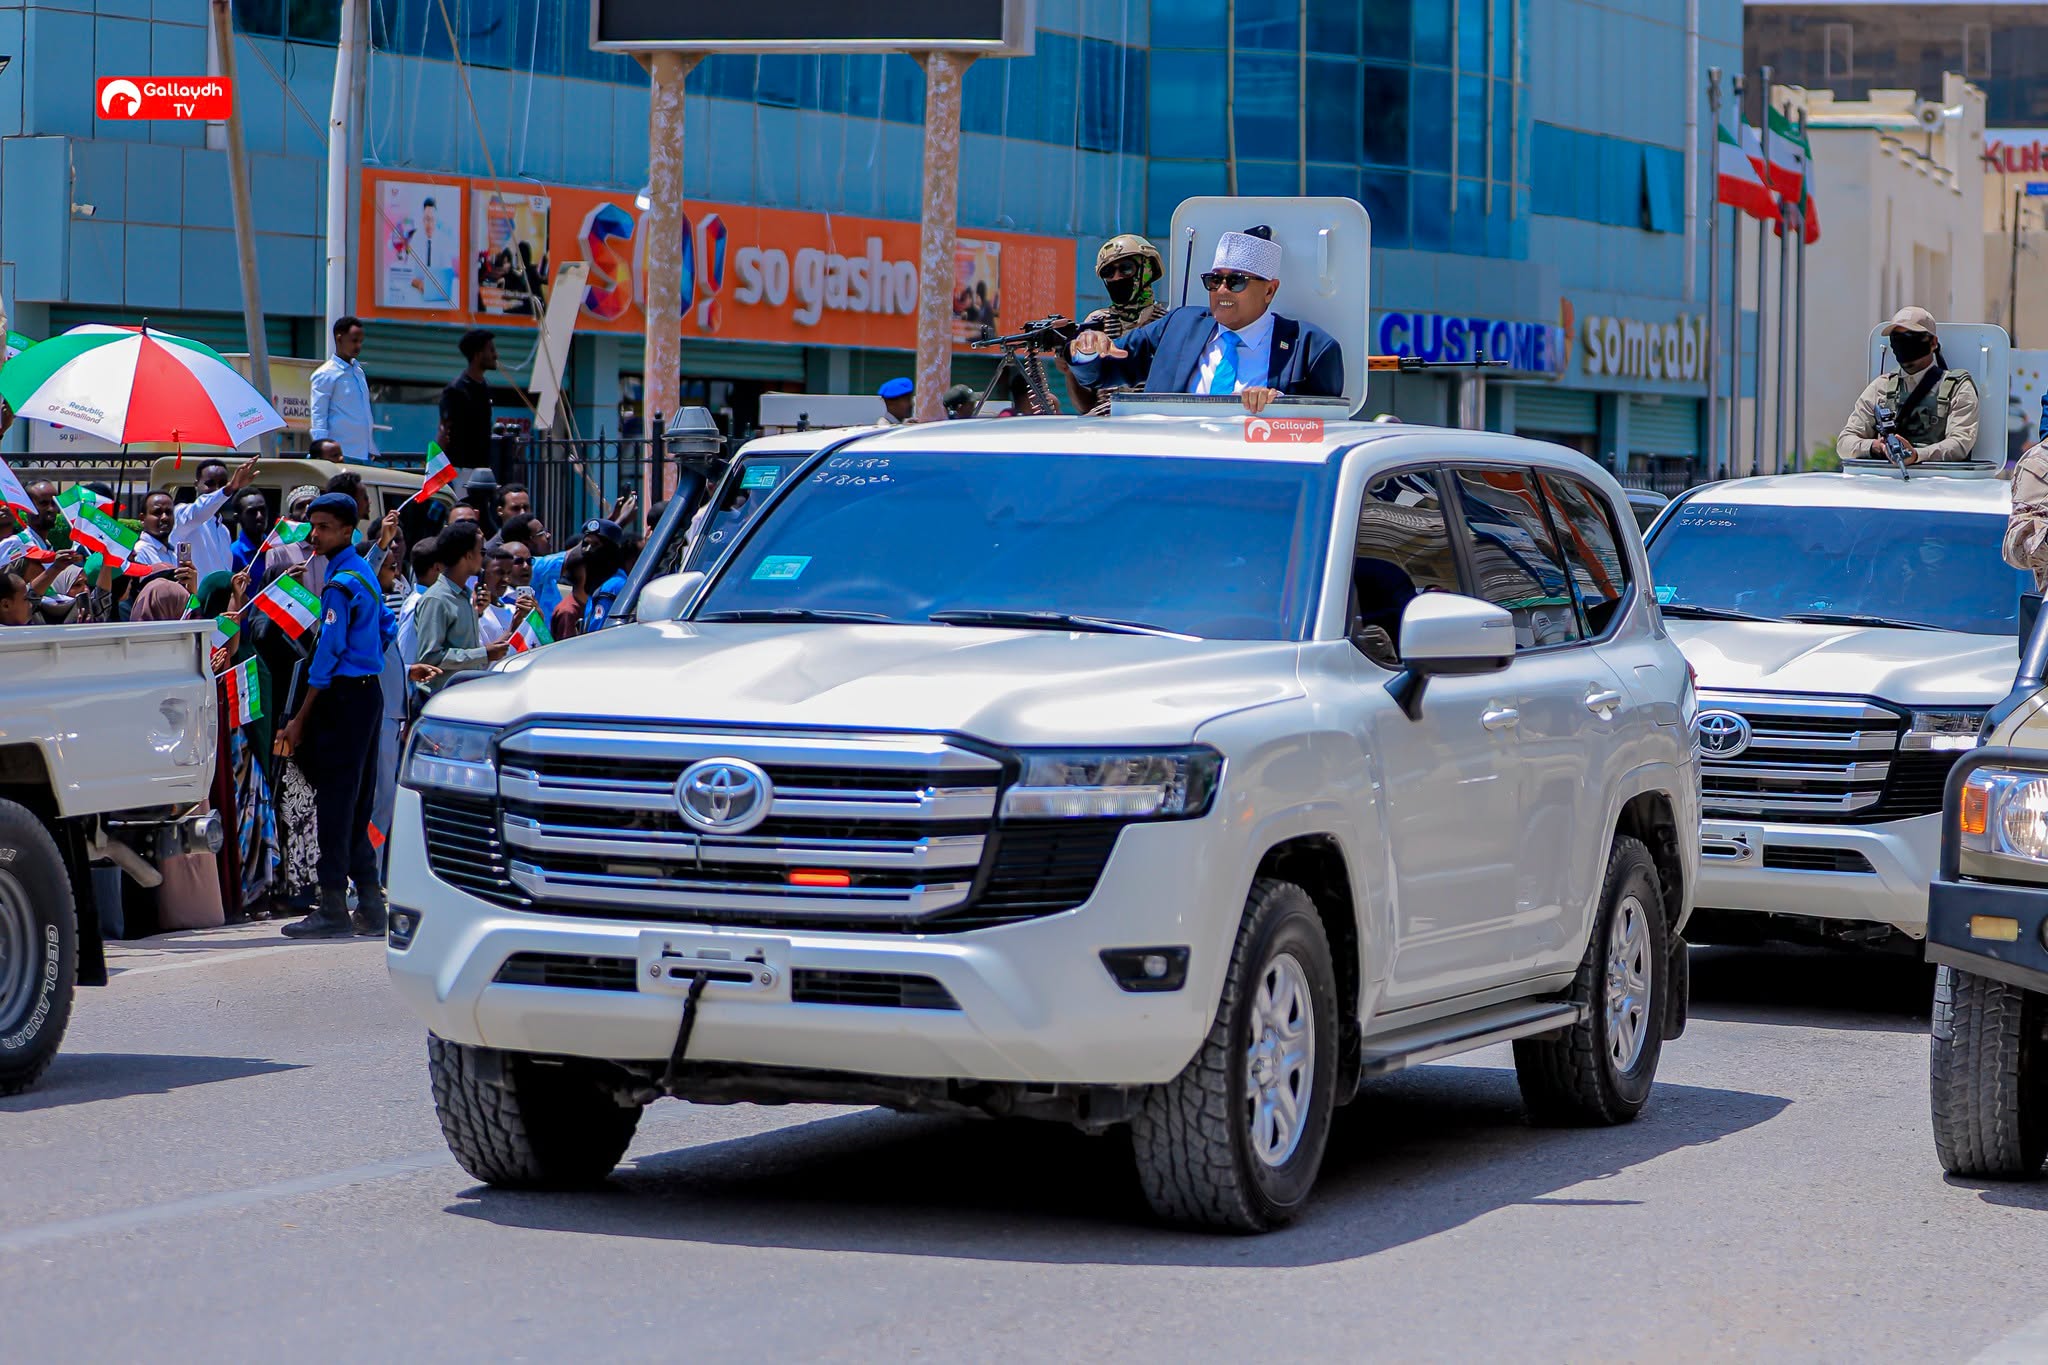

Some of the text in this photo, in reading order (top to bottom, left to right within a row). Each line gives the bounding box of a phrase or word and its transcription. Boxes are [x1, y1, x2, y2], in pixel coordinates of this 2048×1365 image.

[734, 236, 919, 326] so gasho
[60, 407, 102, 424] Somaliland
[2, 924, 60, 1049] GEOLANDAR
